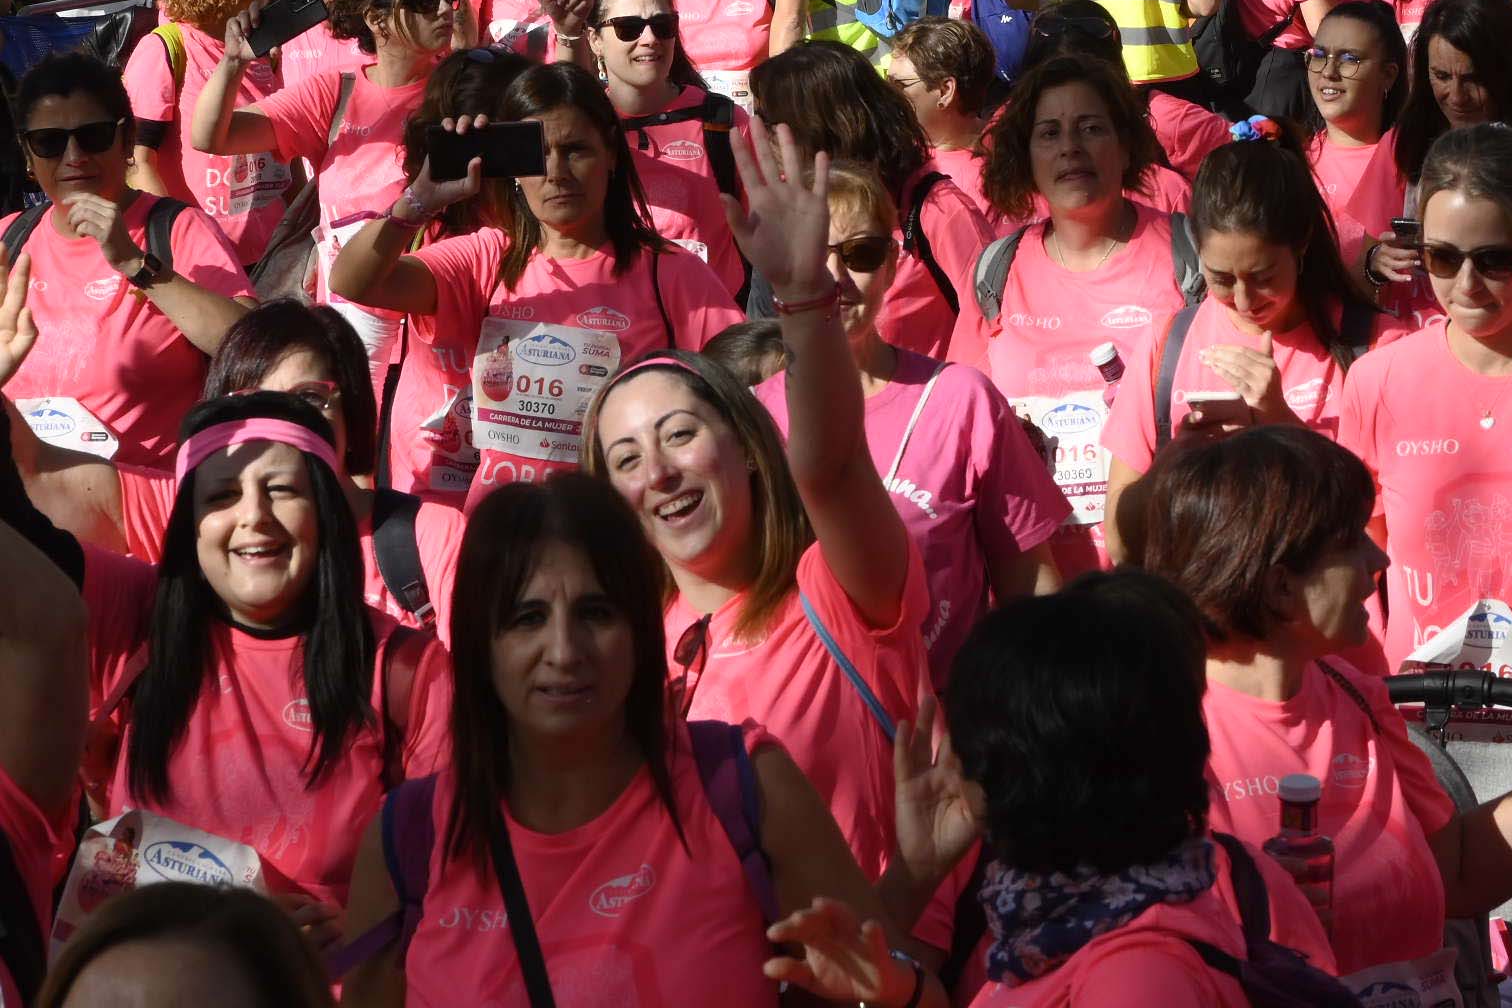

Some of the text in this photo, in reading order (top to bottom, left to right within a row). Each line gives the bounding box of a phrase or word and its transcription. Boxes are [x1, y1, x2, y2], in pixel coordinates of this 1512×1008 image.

[581, 318, 628, 331] ASTURIANA
[1008, 313, 1062, 329] OYSHO
[520, 343, 574, 362] ASTURIANA
[582, 345, 610, 358] SUMA
[516, 375, 565, 398] 016
[518, 398, 556, 415] 30370
[489, 412, 574, 433] CARRERA DE LA MUJER
[487, 430, 520, 445] OYSHO
[1396, 438, 1460, 456] OYSHO
[1057, 468, 1094, 483] 30369
[1061, 485, 1073, 495] DE
[1074, 485, 1084, 494] LA
[1403, 565, 1434, 606] TU
